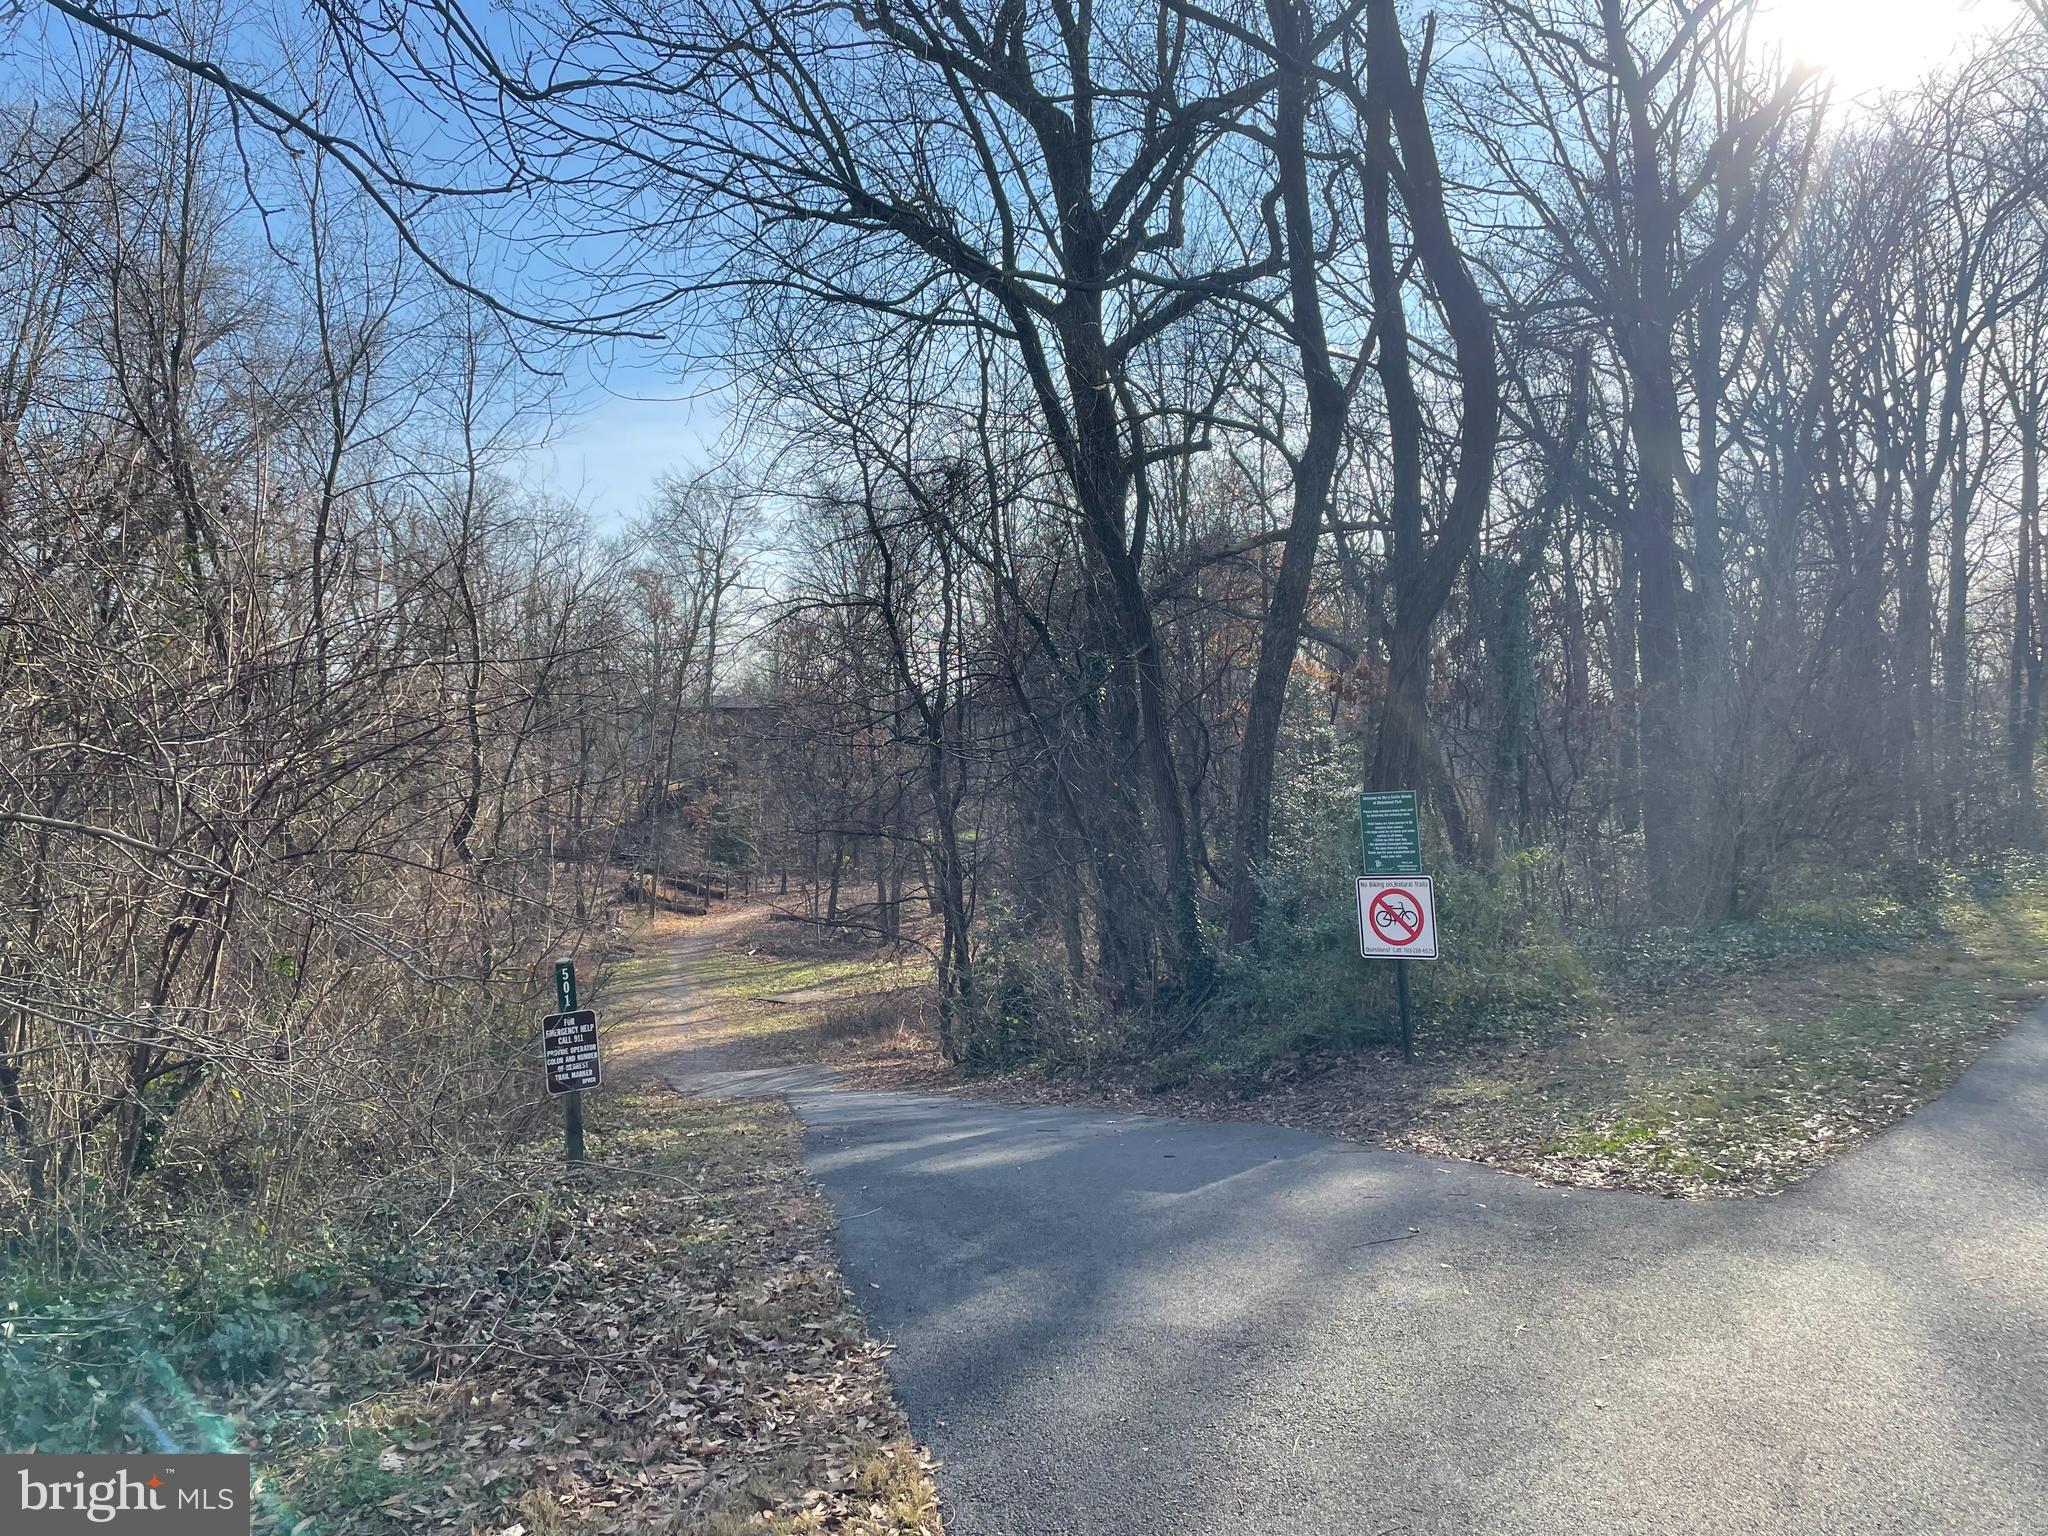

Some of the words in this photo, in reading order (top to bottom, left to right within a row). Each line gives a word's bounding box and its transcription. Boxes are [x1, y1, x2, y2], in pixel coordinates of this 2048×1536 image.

[562, 968, 570, 1006] 501
[564, 1018, 575, 1026] FOR
[546, 1026, 578, 1038] EMERGENCY
[580, 1024, 594, 1032] HELP
[558, 1036, 572, 1045] CALL
[574, 1034, 584, 1042] 911
[547, 1048, 569, 1057] PROVIDE
[570, 1044, 596, 1054] OPERATOR
[547, 1057, 564, 1066] COLOR
[577, 1052, 597, 1060] NUMBER
[566, 1062, 588, 1071] NEAREST
[571, 1069, 592, 1078] MARKER
